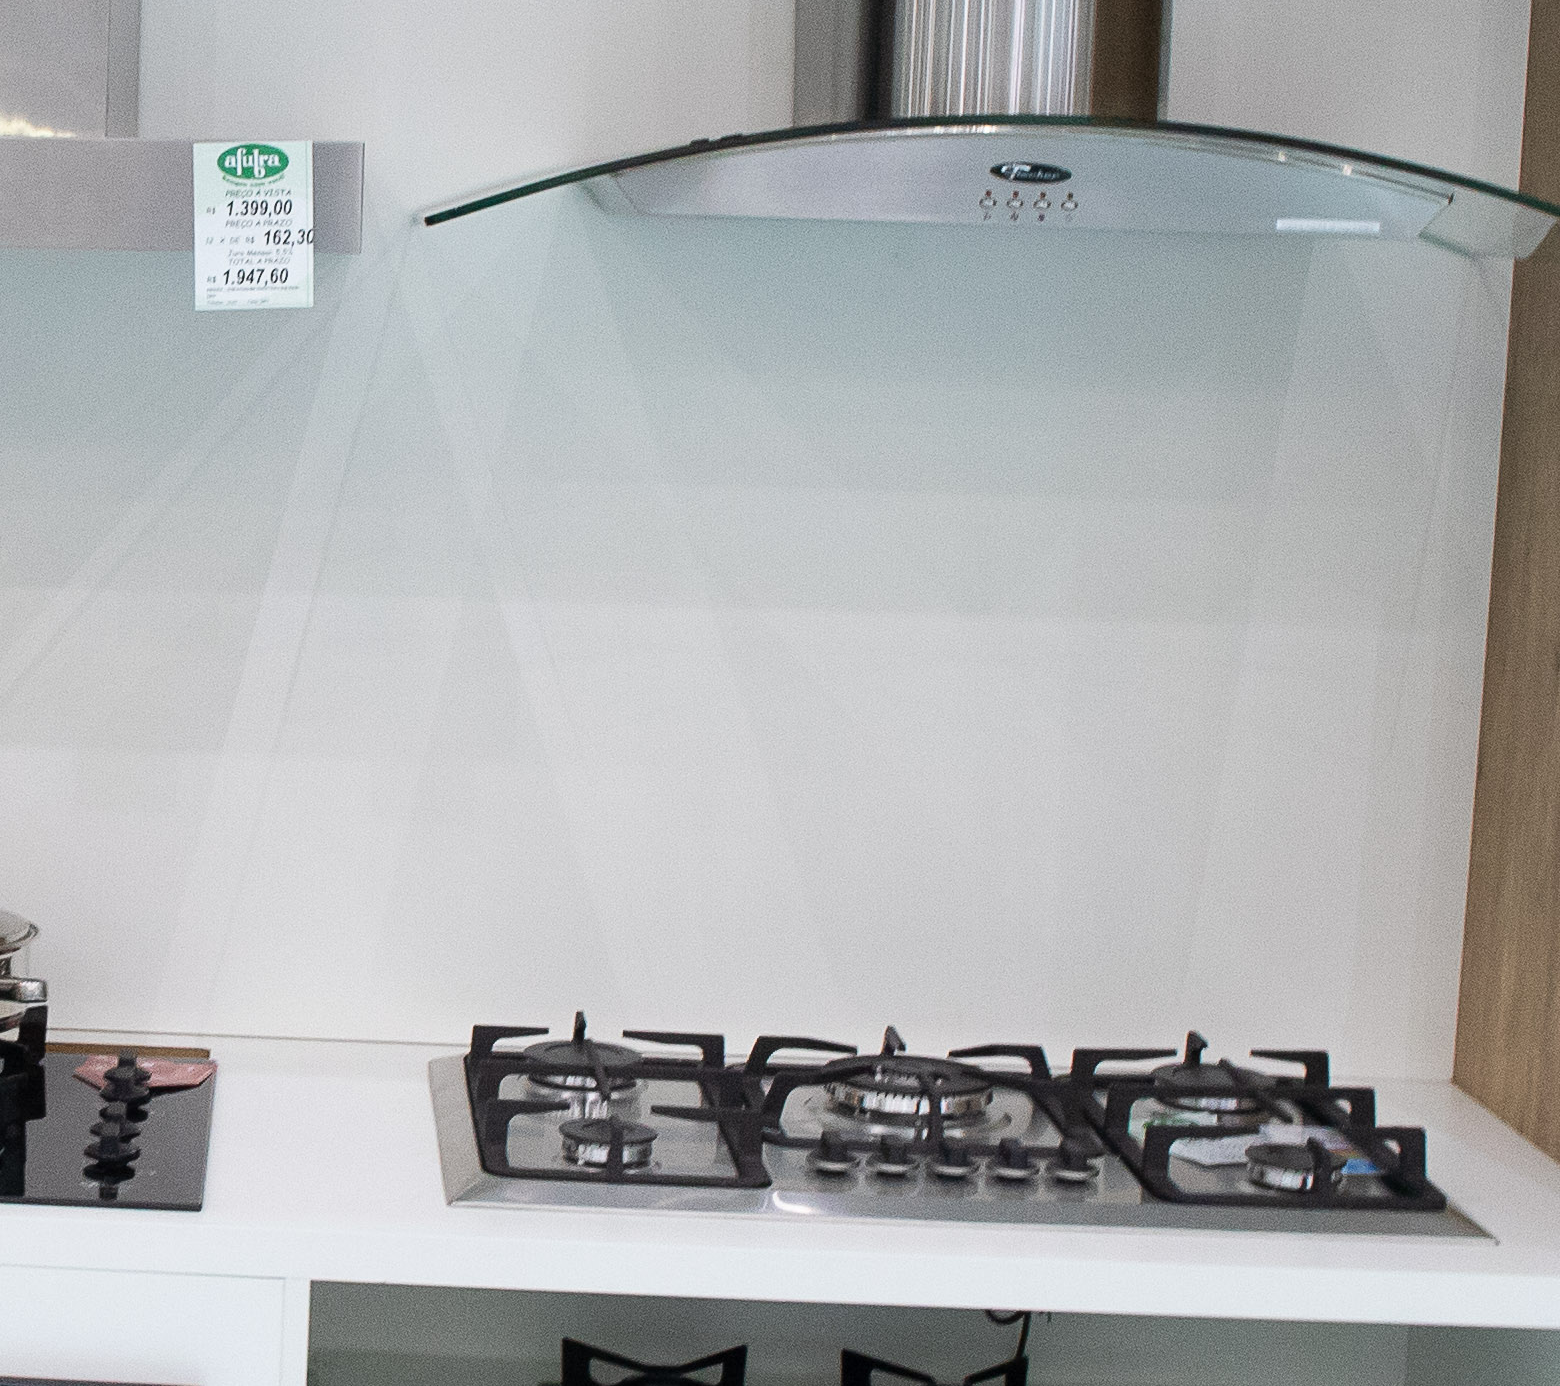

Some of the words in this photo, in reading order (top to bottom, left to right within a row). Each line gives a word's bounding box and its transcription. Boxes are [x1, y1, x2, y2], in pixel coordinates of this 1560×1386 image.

[226, 199, 293, 218] 1.399,00
[264, 229, 314, 247] 162,30
[223, 268, 290, 287] 1.947,60
